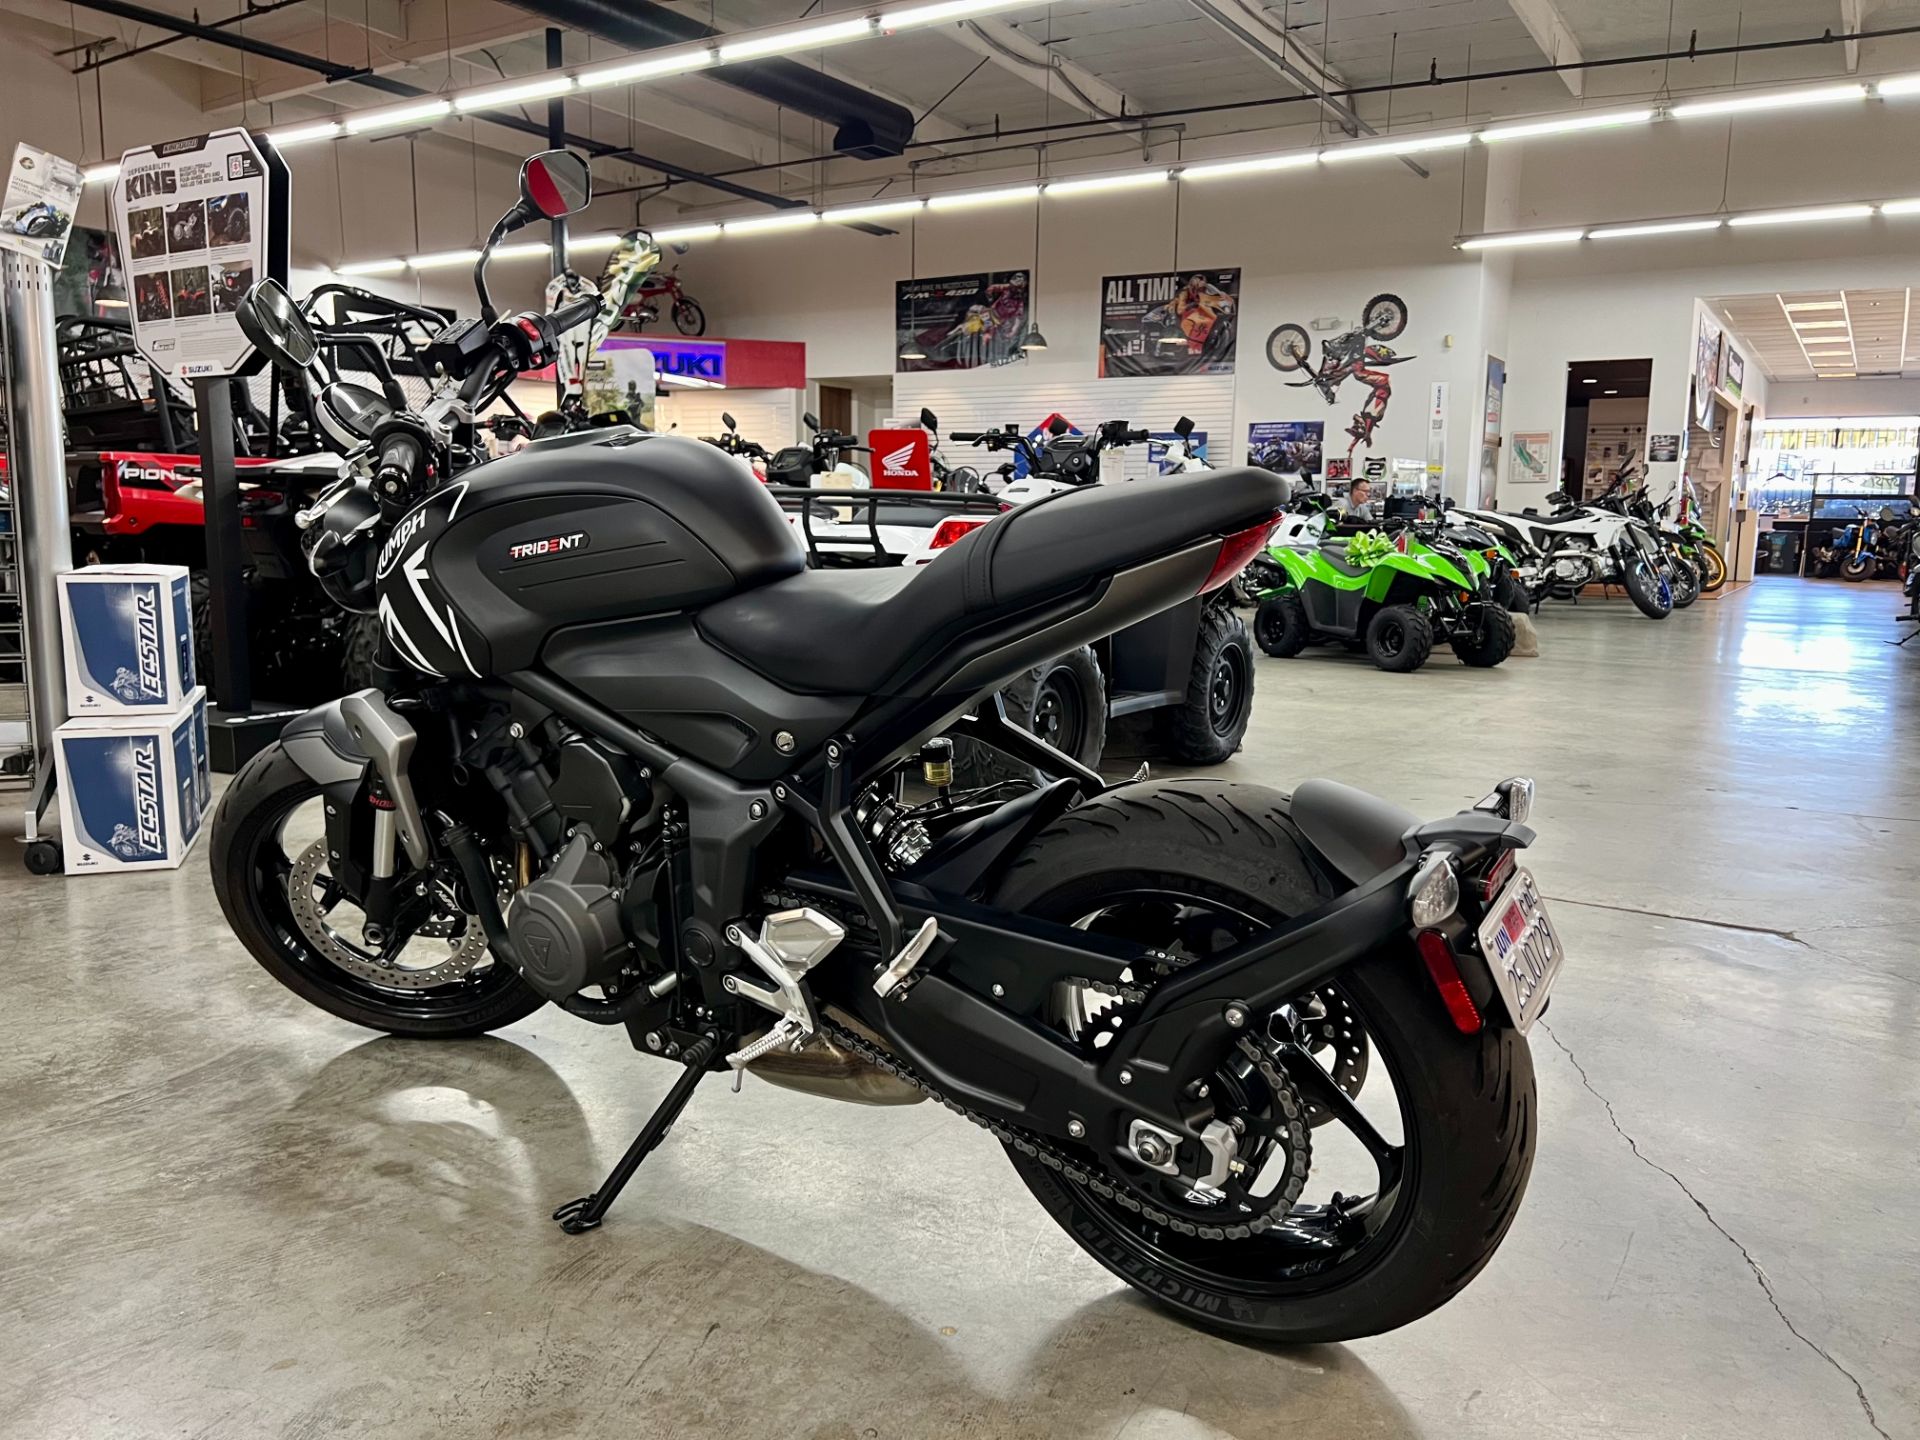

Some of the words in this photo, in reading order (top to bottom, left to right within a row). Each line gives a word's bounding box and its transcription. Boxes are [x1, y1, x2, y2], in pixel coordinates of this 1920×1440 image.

[125, 170, 177, 202] KING
[1106, 280, 1133, 303] ALL
[188, 365, 213, 374] SUZUKI
[883, 469, 919, 477] HONDA
[510, 533, 583, 558] TRIDENT
[137, 585, 163, 698] ECSTAR
[136, 740, 162, 853] ECSTAR
[1494, 926, 1512, 959] JUN
[1073, 1221, 1222, 1312] MICHELIN
